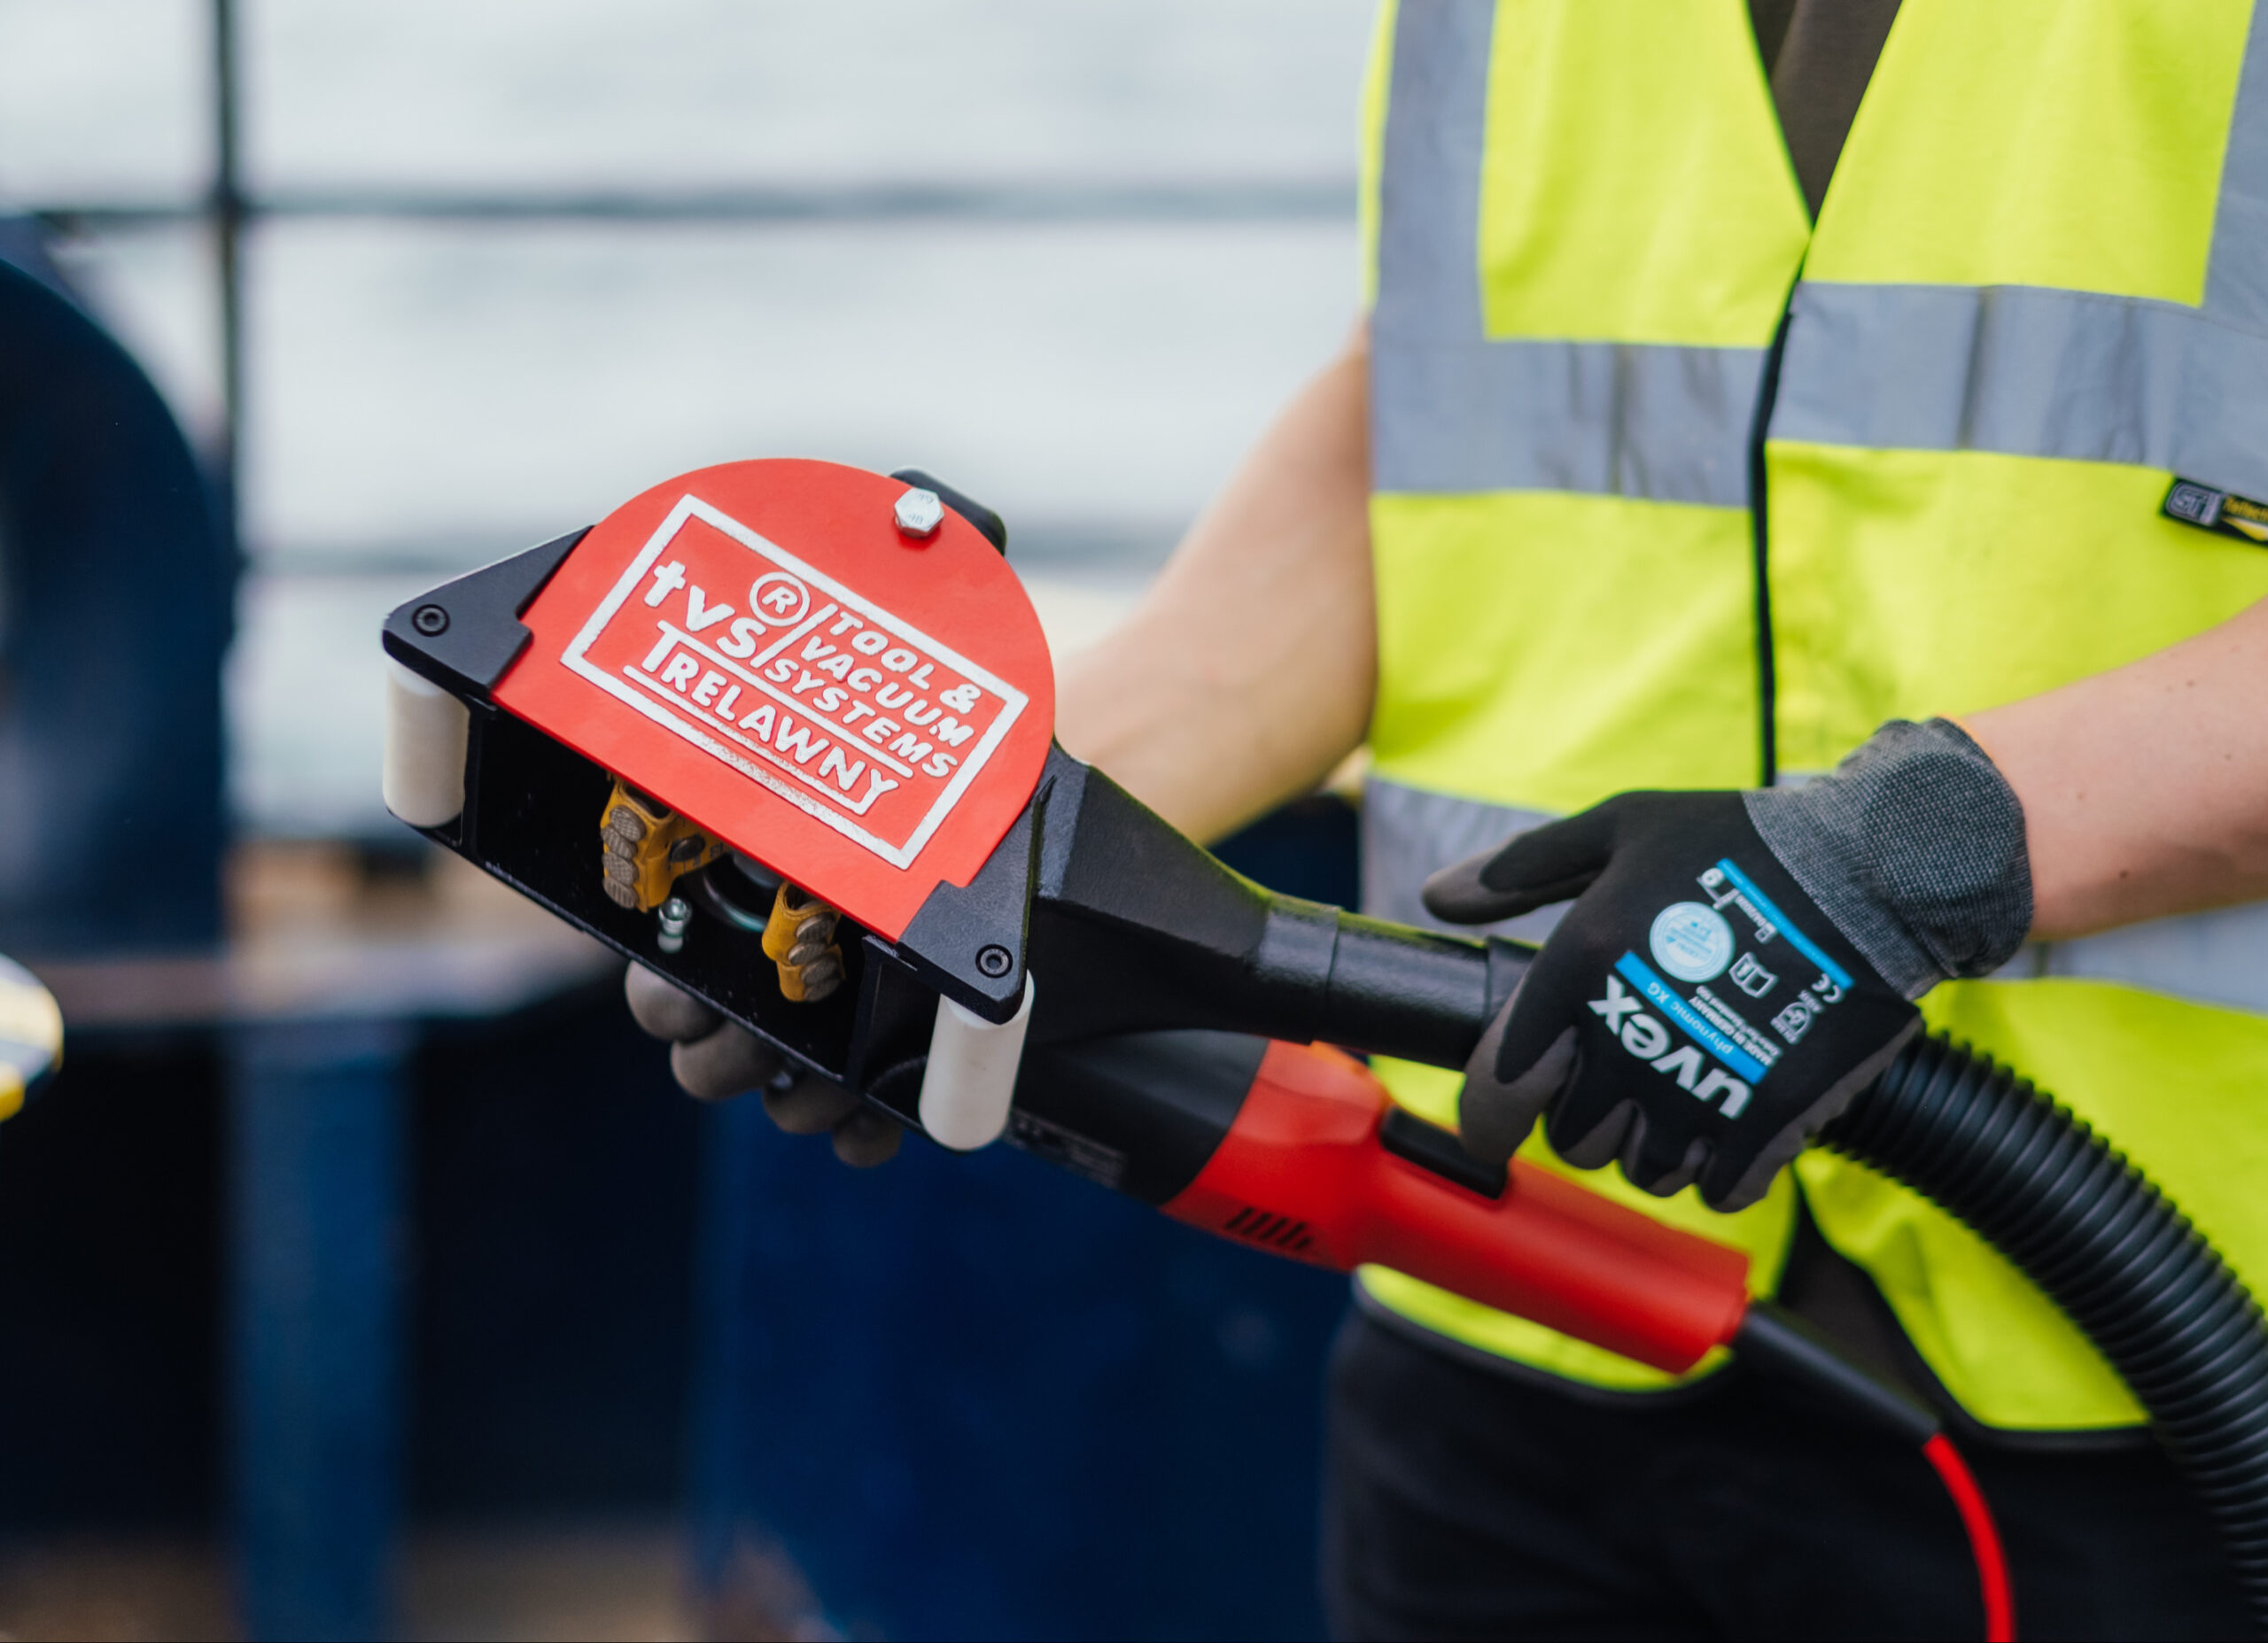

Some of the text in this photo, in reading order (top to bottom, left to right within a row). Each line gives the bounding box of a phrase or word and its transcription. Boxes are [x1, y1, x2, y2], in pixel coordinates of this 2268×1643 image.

[644, 561, 766, 663] tvs
[830, 611, 982, 715] TOOL &
[642, 620, 899, 815] TRELAWNY
[764, 656, 959, 778] SYSTEMS
[800, 636, 974, 748] VACUUM
[1588, 974, 1752, 1120] uvex
[1646, 980, 1734, 1056] phynomic XG
[1687, 994, 1736, 1036] GERMANY
[1742, 1038, 1773, 1067] MADE
